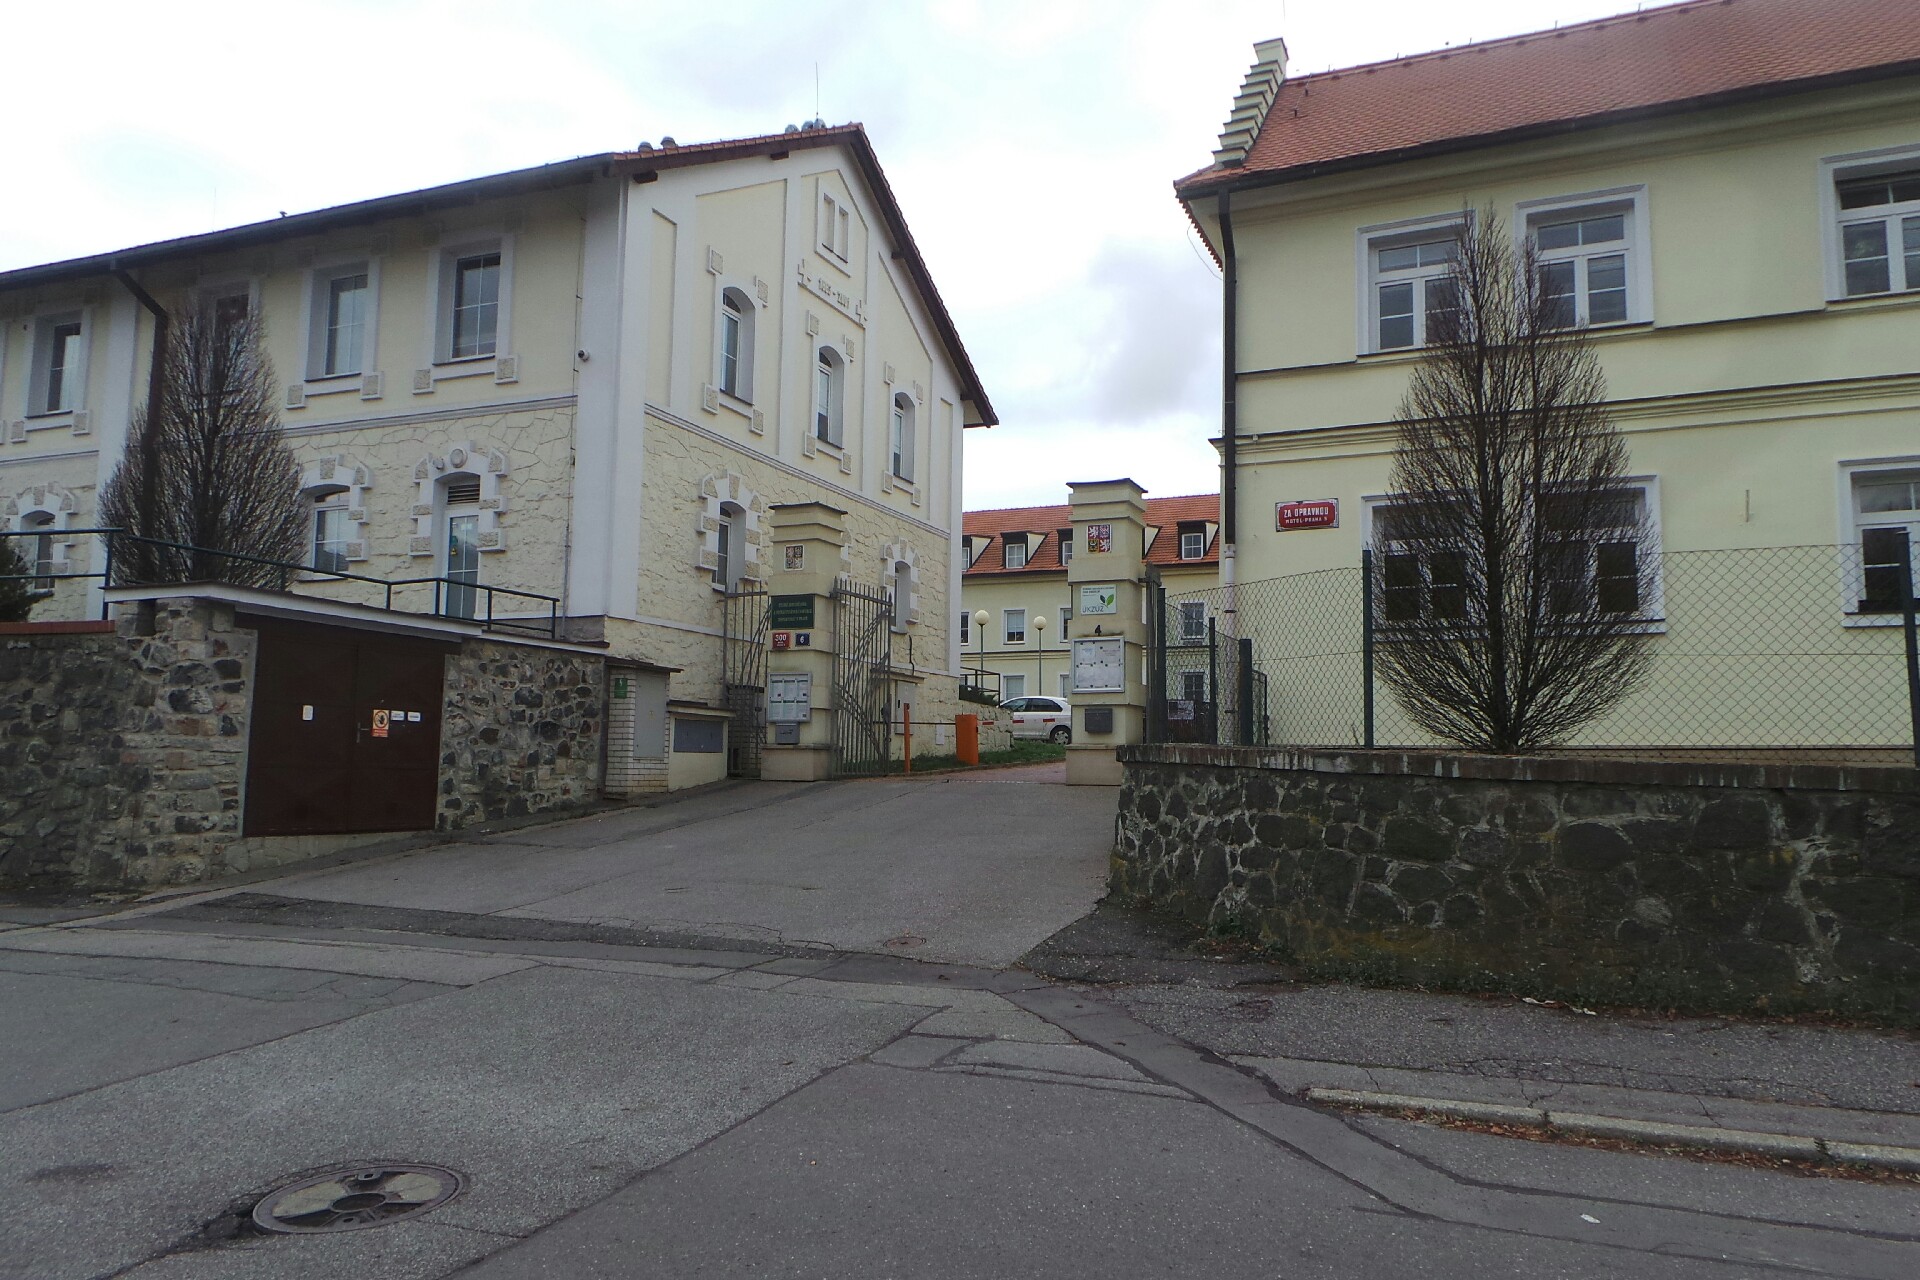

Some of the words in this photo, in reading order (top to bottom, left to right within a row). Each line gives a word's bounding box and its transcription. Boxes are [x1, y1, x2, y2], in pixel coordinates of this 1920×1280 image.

[1284, 509, 1292, 518] ZA
[1294, 506, 1329, 517] OPRAVNOU
[1094, 624, 1102, 636] 4
[799, 635, 805, 644] 6
